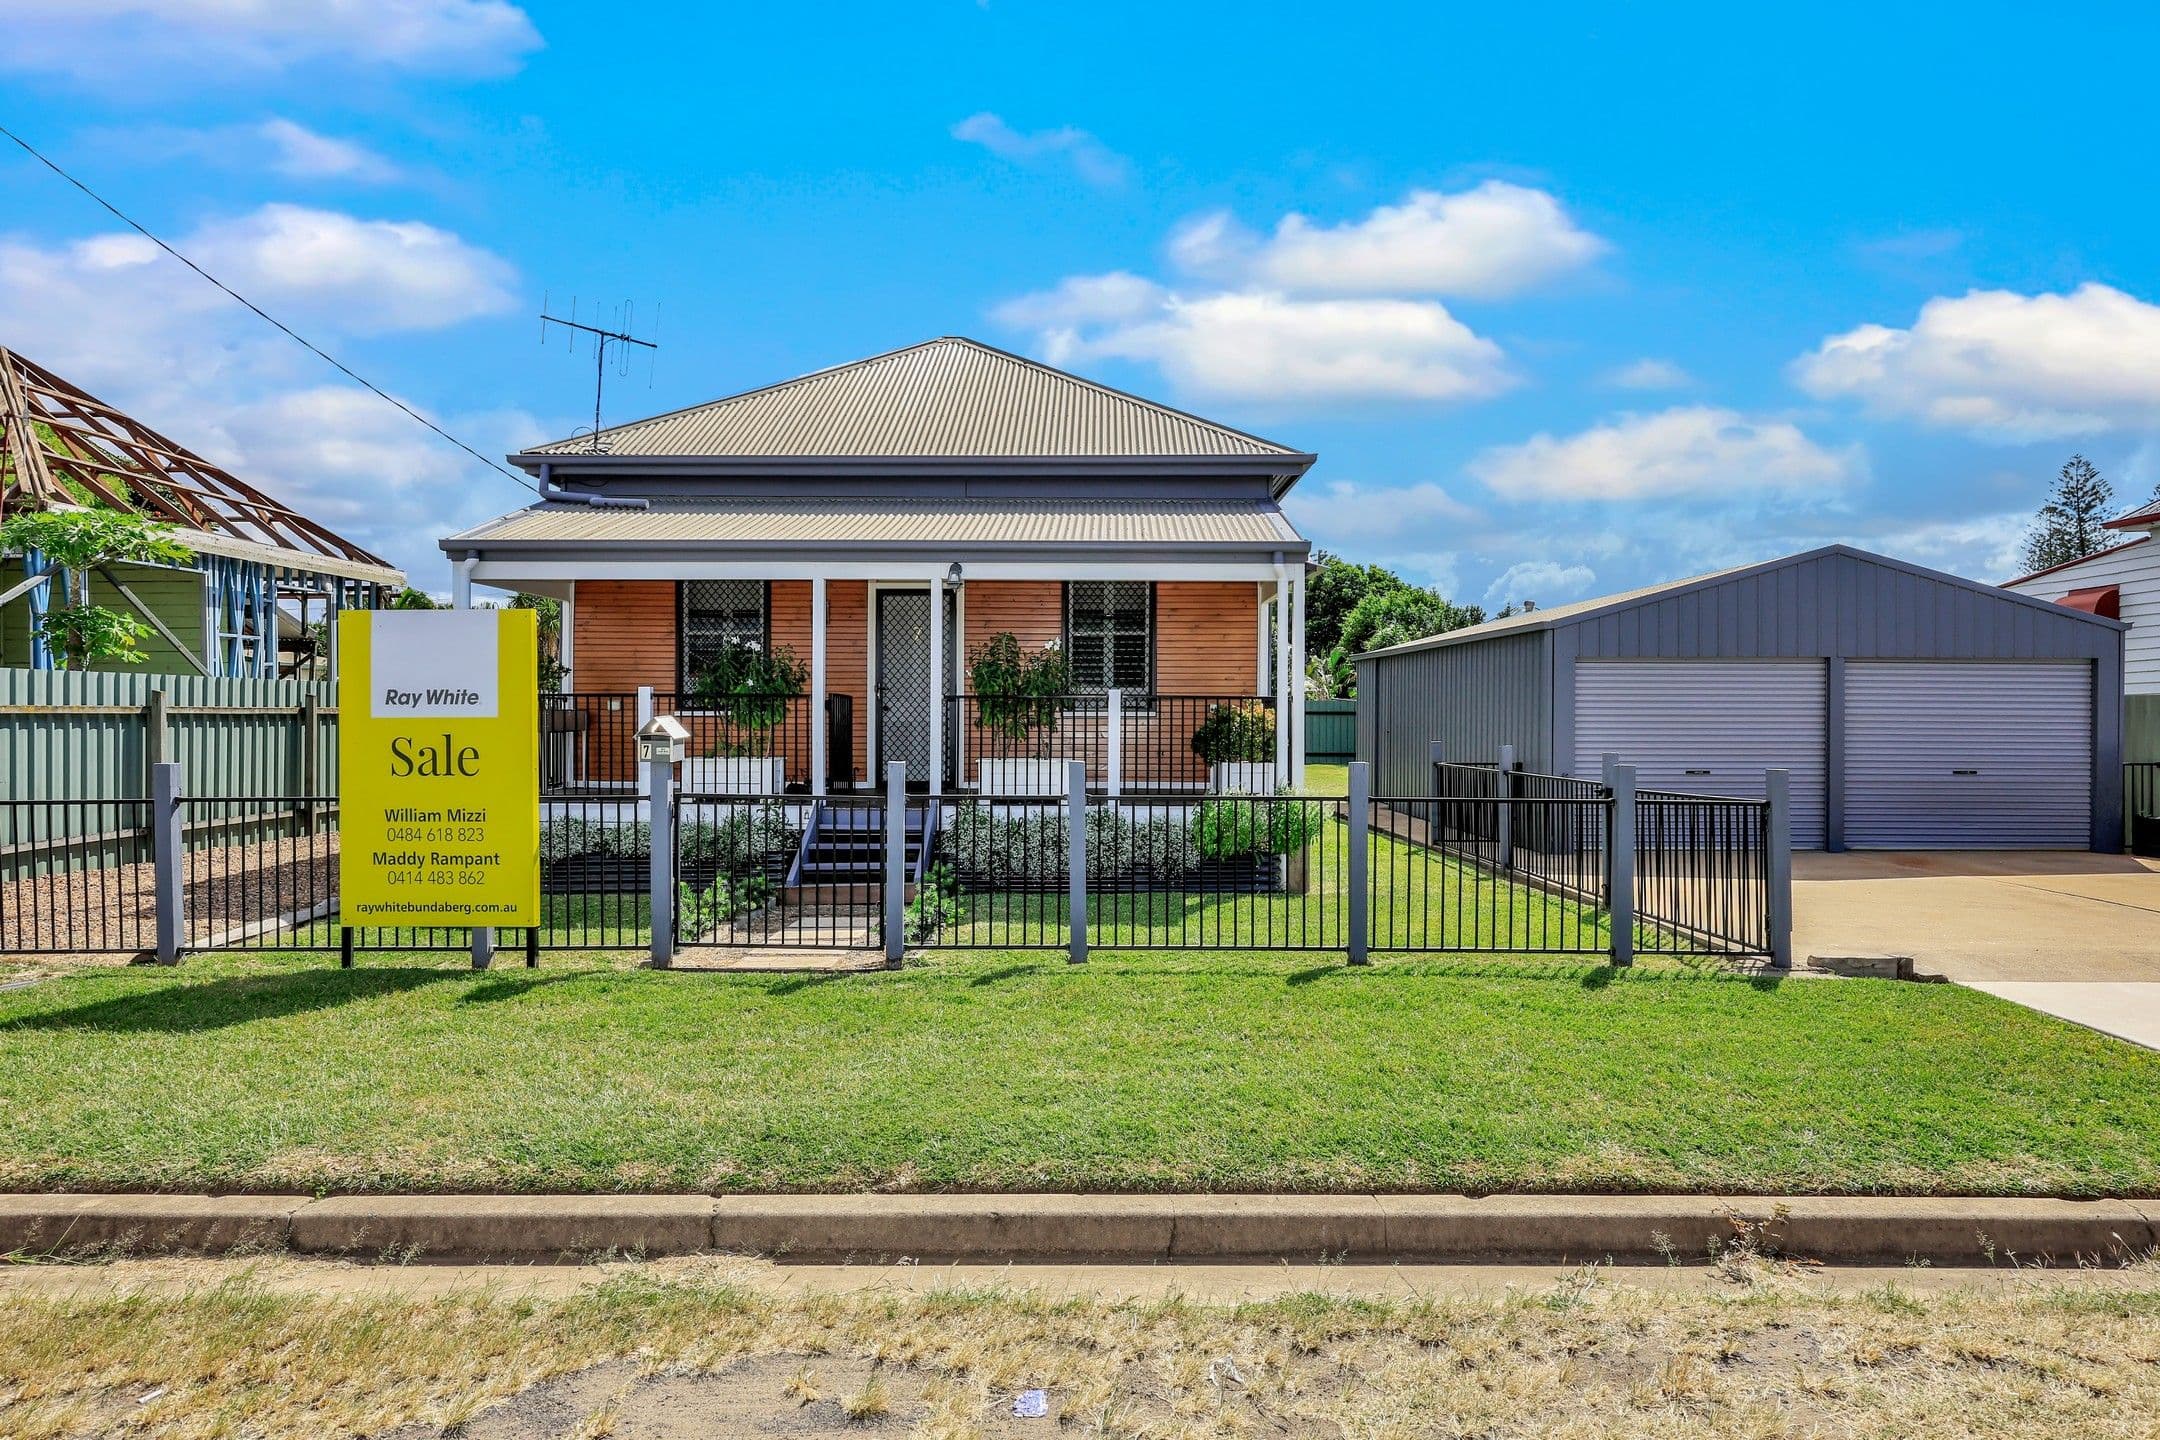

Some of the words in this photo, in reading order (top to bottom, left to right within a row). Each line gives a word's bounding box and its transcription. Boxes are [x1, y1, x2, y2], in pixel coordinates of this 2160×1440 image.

[385, 689, 422, 708] Ray
[426, 689, 479, 705] White
[391, 733, 480, 777] Sale
[643, 745, 650, 758] 7
[384, 808, 441, 822] William
[447, 808, 486, 822] Mizzi
[387, 828, 422, 842] 0484
[427, 828, 453, 842] 618
[458, 828, 484, 842] 823
[373, 851, 425, 868] Maddy
[431, 852, 501, 868] Rampant
[388, 871, 423, 885] 0414
[428, 871, 454, 885] 483
[459, 871, 485, 885] 862
[356, 901, 517, 915] raywhitebundaberg.com.au
